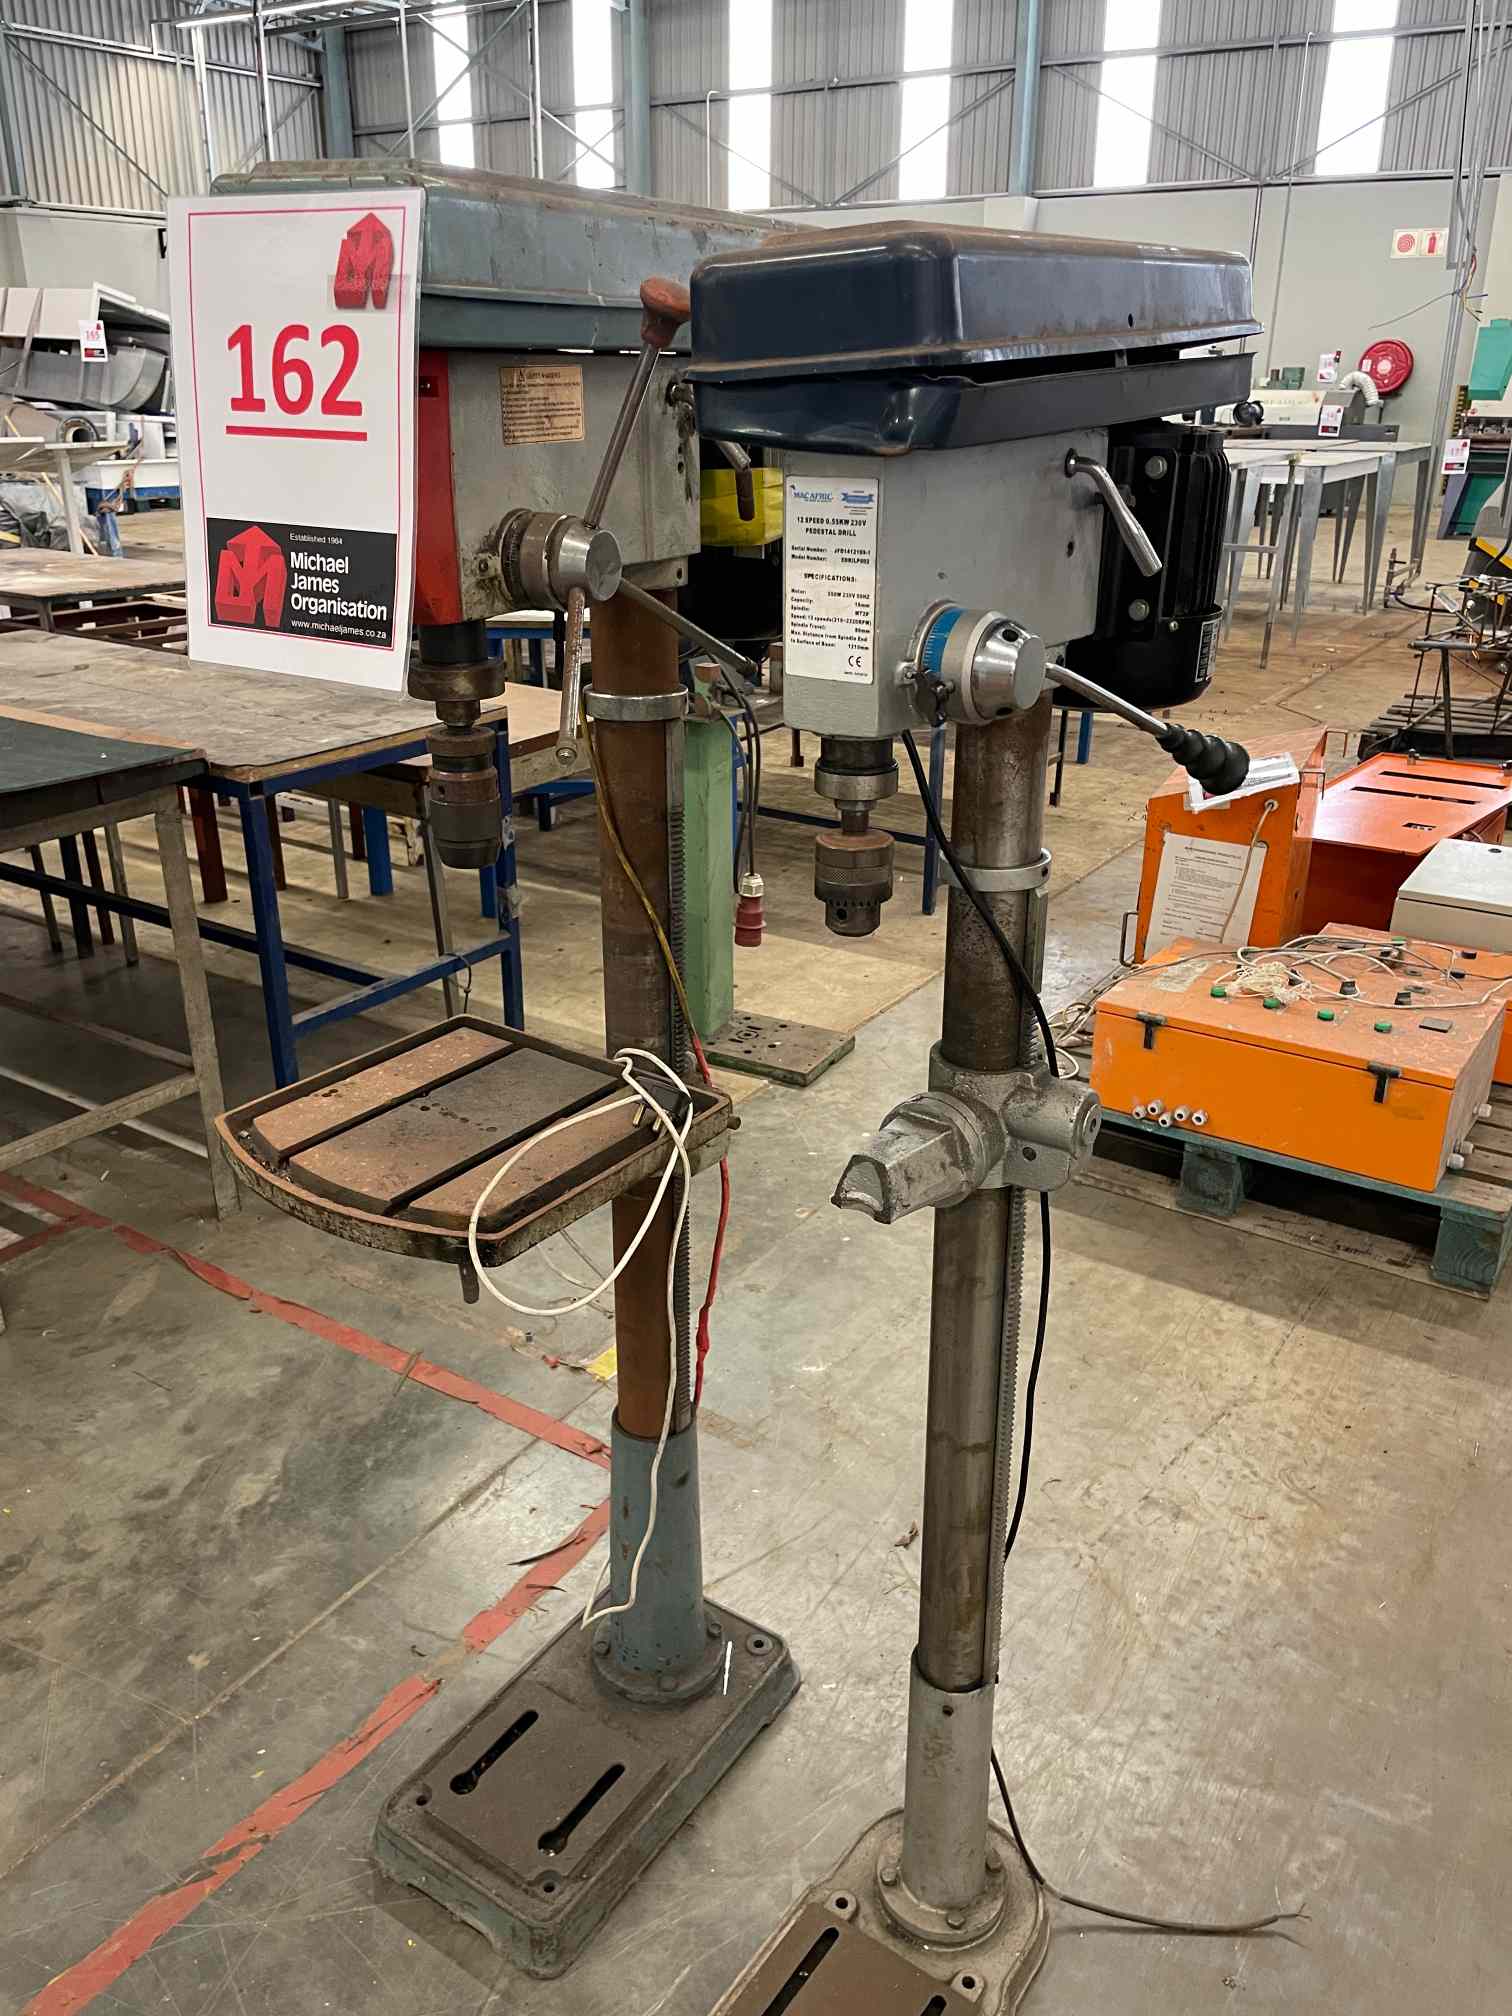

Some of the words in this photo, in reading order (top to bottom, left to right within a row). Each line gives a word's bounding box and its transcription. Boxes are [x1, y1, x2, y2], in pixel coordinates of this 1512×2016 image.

[228, 324, 363, 416] 162
[805, 517, 824, 525] SPEED
[826, 518, 850, 526] 0.55KW
[850, 519, 867, 527] 230V
[805, 527, 836, 536] PEDESTAL
[838, 529, 857, 537] DRILL
[289, 532, 326, 545] Established
[290, 551, 349, 574] Michael
[290, 572, 340, 594] James
[804, 573, 857, 583] SPECIFICATIONS:
[290, 593, 388, 621] Organisation
[290, 620, 387, 640] www.michaeljames.co.za
